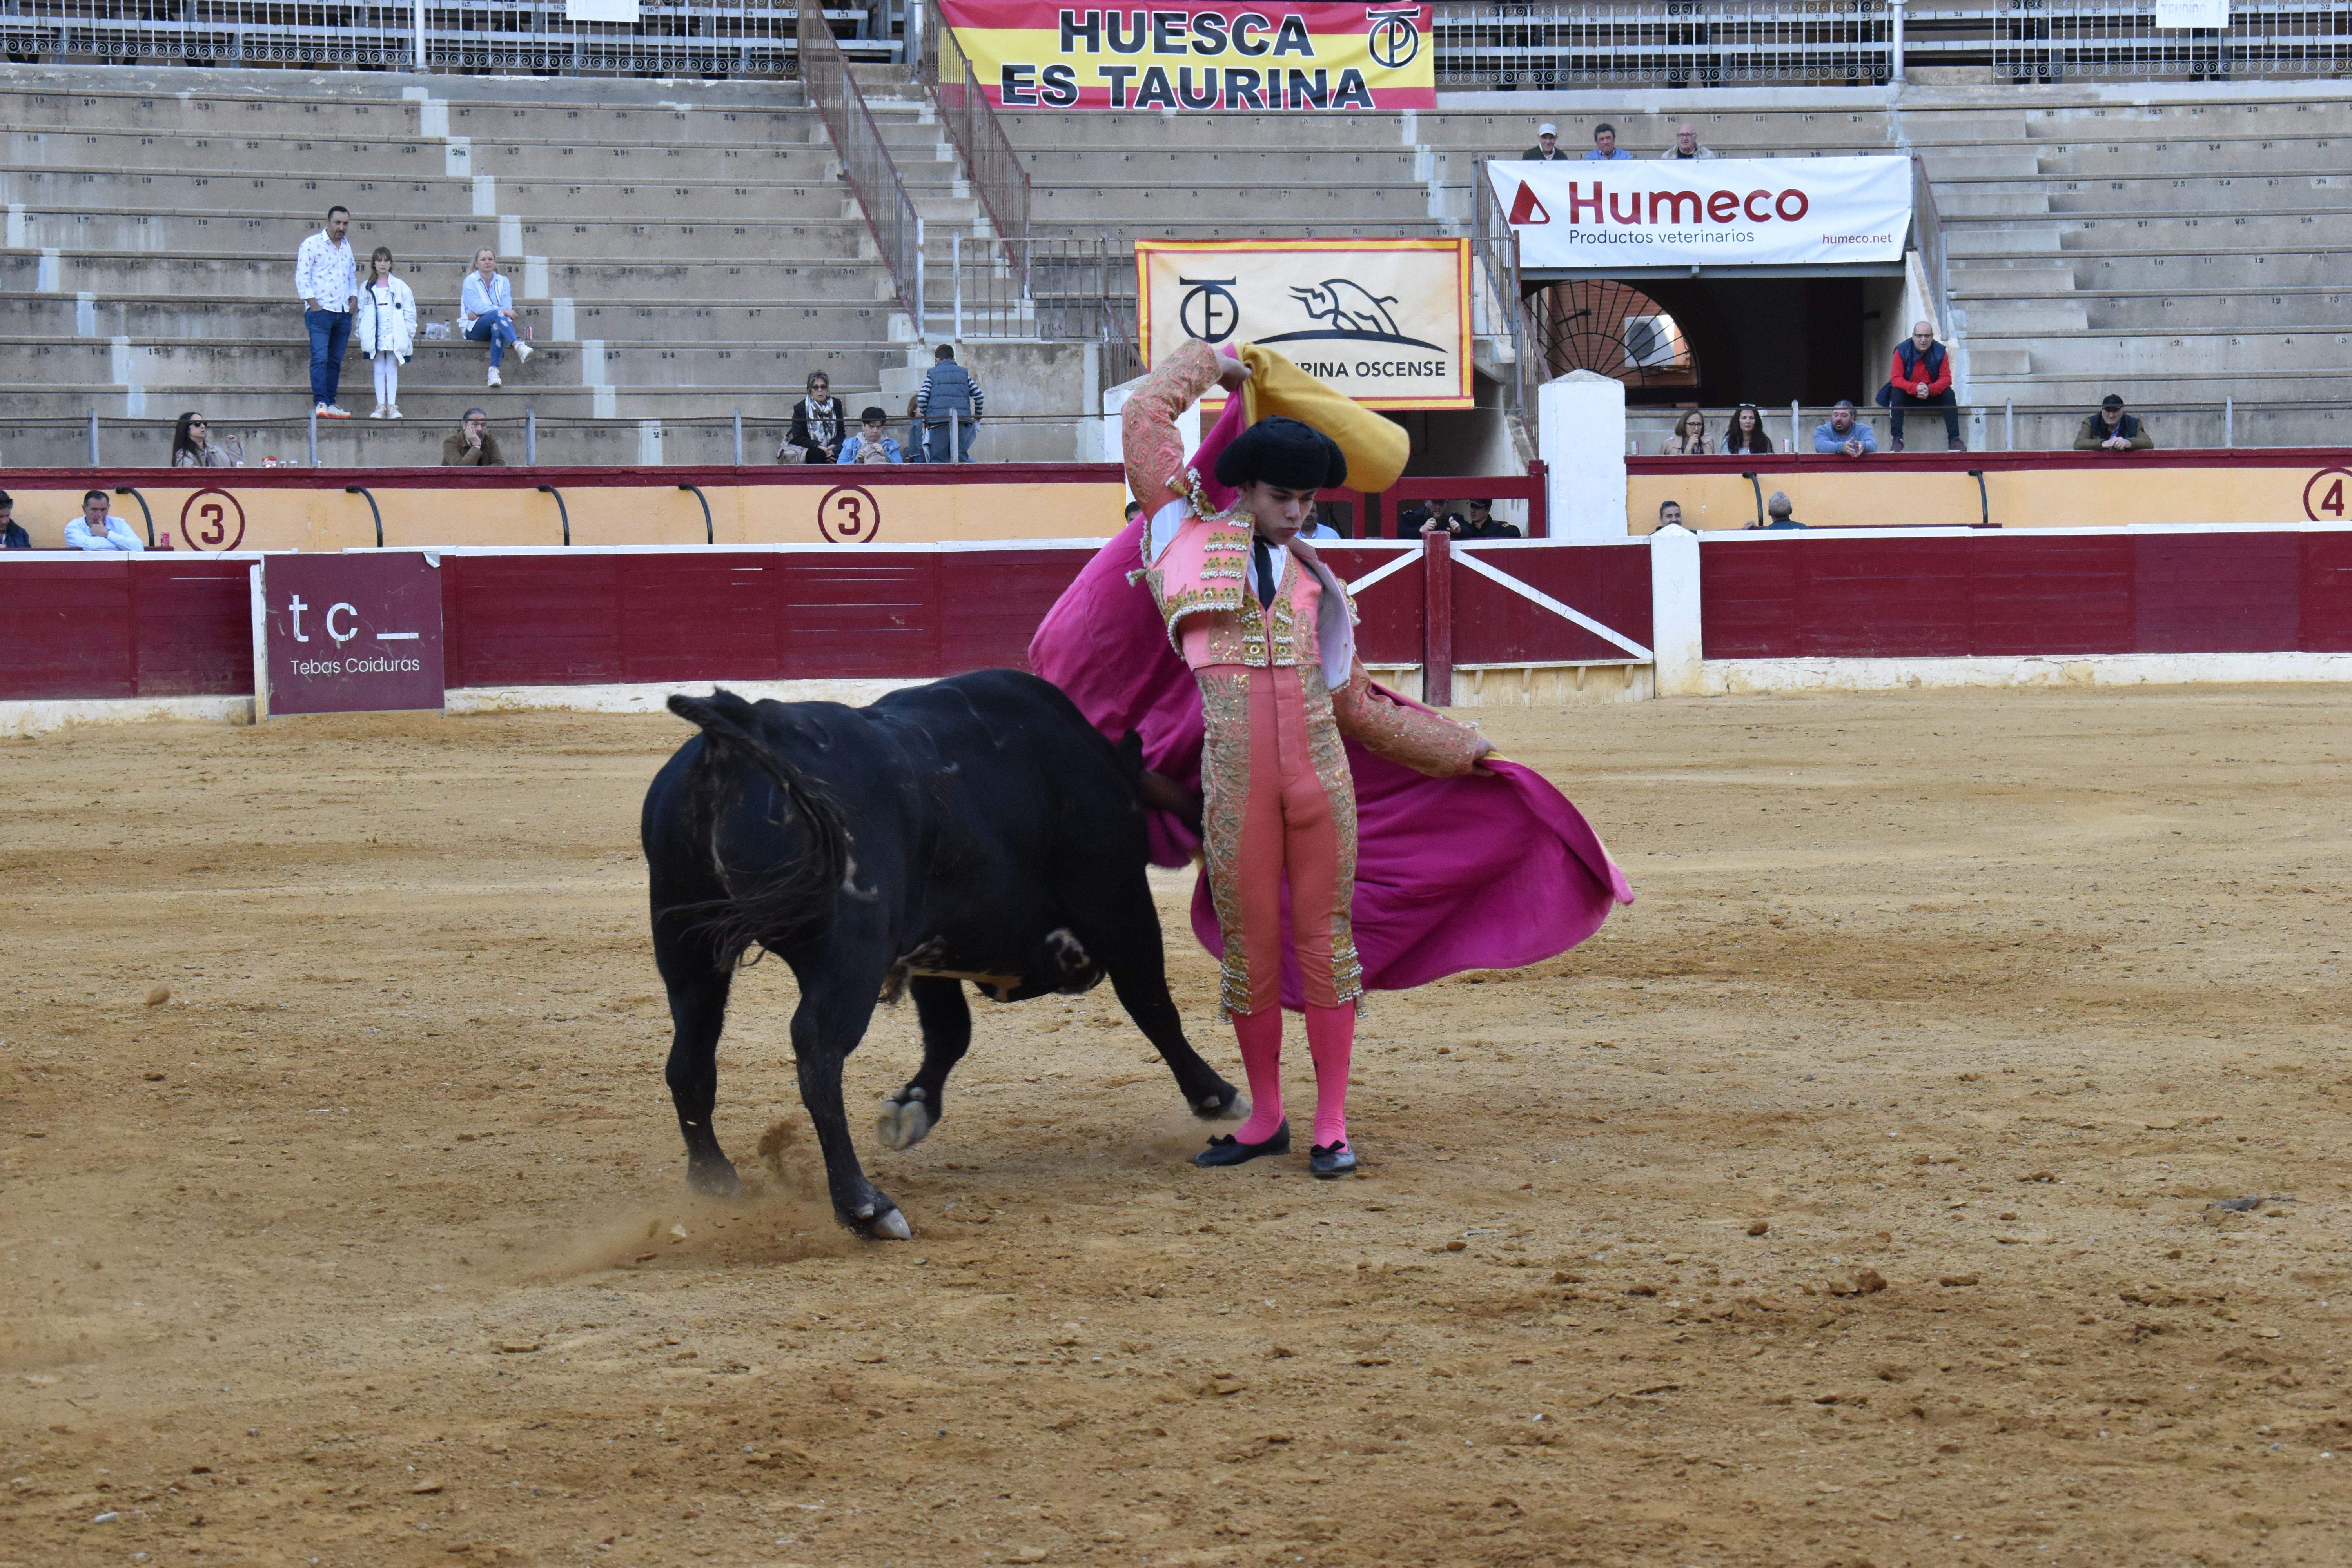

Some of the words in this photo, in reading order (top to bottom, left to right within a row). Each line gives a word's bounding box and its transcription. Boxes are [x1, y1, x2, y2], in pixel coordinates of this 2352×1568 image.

[1060, 10, 1315, 57] HUESCA
[1001, 64, 1079, 107] ES
[1099, 65, 1375, 110] TAURINA
[1569, 181, 1808, 224] Humeco
[1570, 229, 1653, 244] Productos
[1658, 230, 1754, 243] veterinarios
[1823, 233, 1892, 244] humeco.net
[1295, 362, 1349, 377] RINA
[1355, 361, 1445, 377] OSCENSE
[838, 497, 861, 535] 3
[2321, 479, 2345, 517] 4
[201, 504, 224, 544] 3
[290, 659, 341, 675] Tebas
[345, 657, 420, 673] Coiduras
